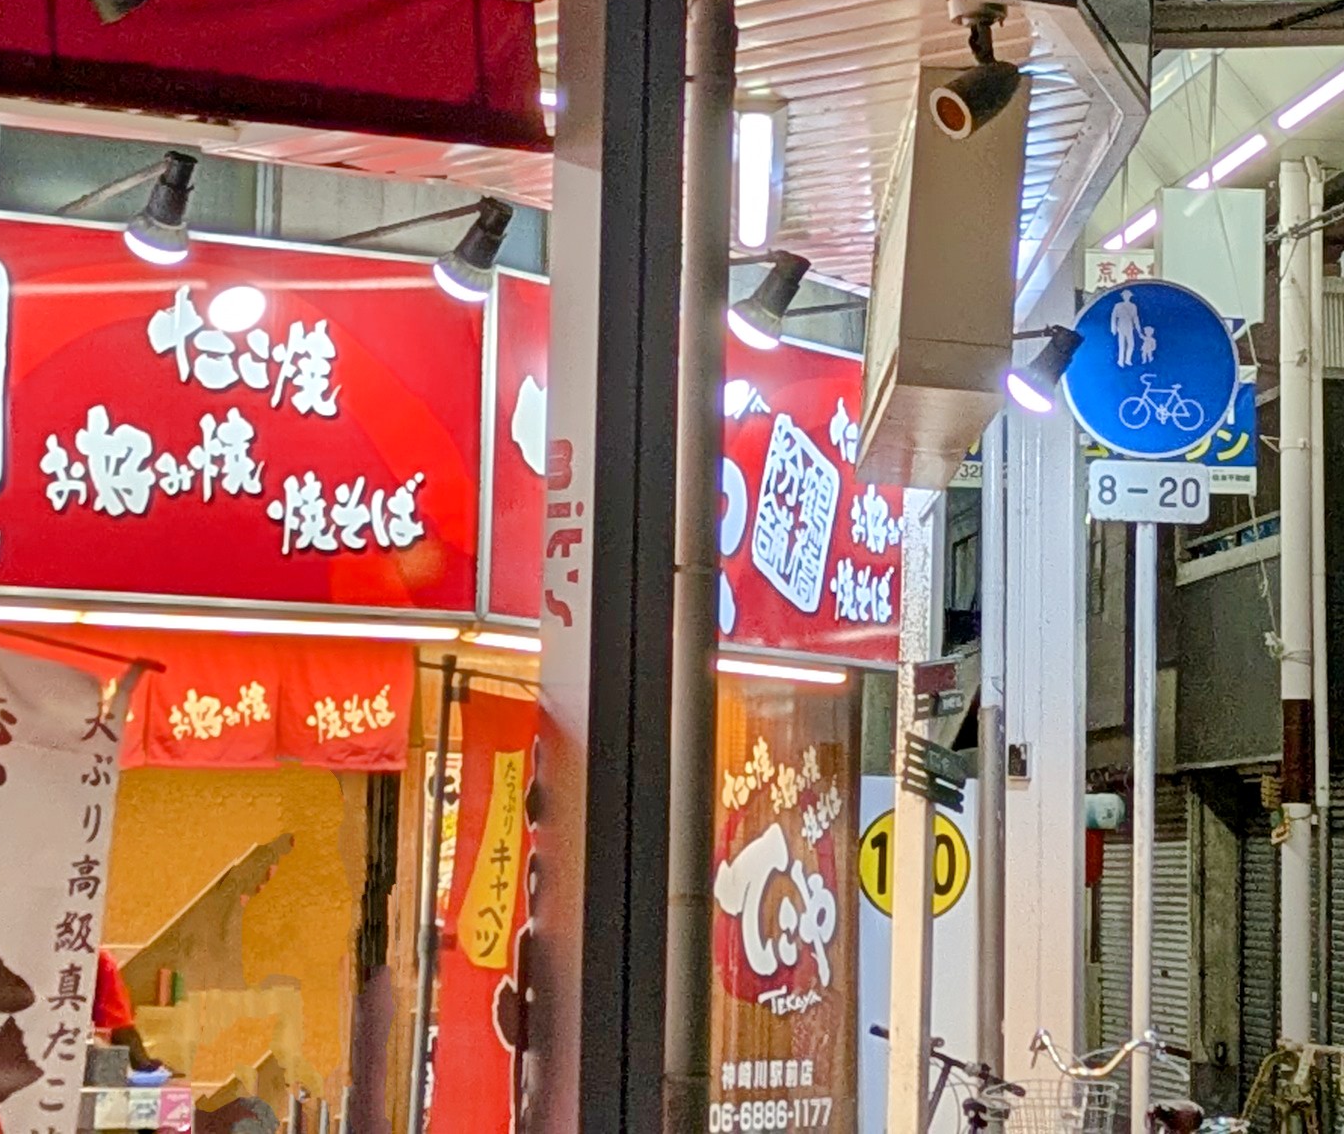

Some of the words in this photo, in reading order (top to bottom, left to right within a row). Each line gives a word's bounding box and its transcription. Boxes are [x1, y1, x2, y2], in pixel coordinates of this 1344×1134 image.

[148, 285, 342, 417] たこ焼
[40, 404, 265, 516] お好み焼
[267, 470, 425, 555] 焼そば
[851, 483, 904, 554] お好み
[830, 558, 893, 624] 焼そば
[168, 681, 271, 741] お好み焼
[306, 684, 396, 744] 焼そば
[30, 701, 120, 1134] 大ぶり高級真だこ
[713, 822, 837, 988] てこや
[708, 1097, 834, 1133] 06-6886-1177
